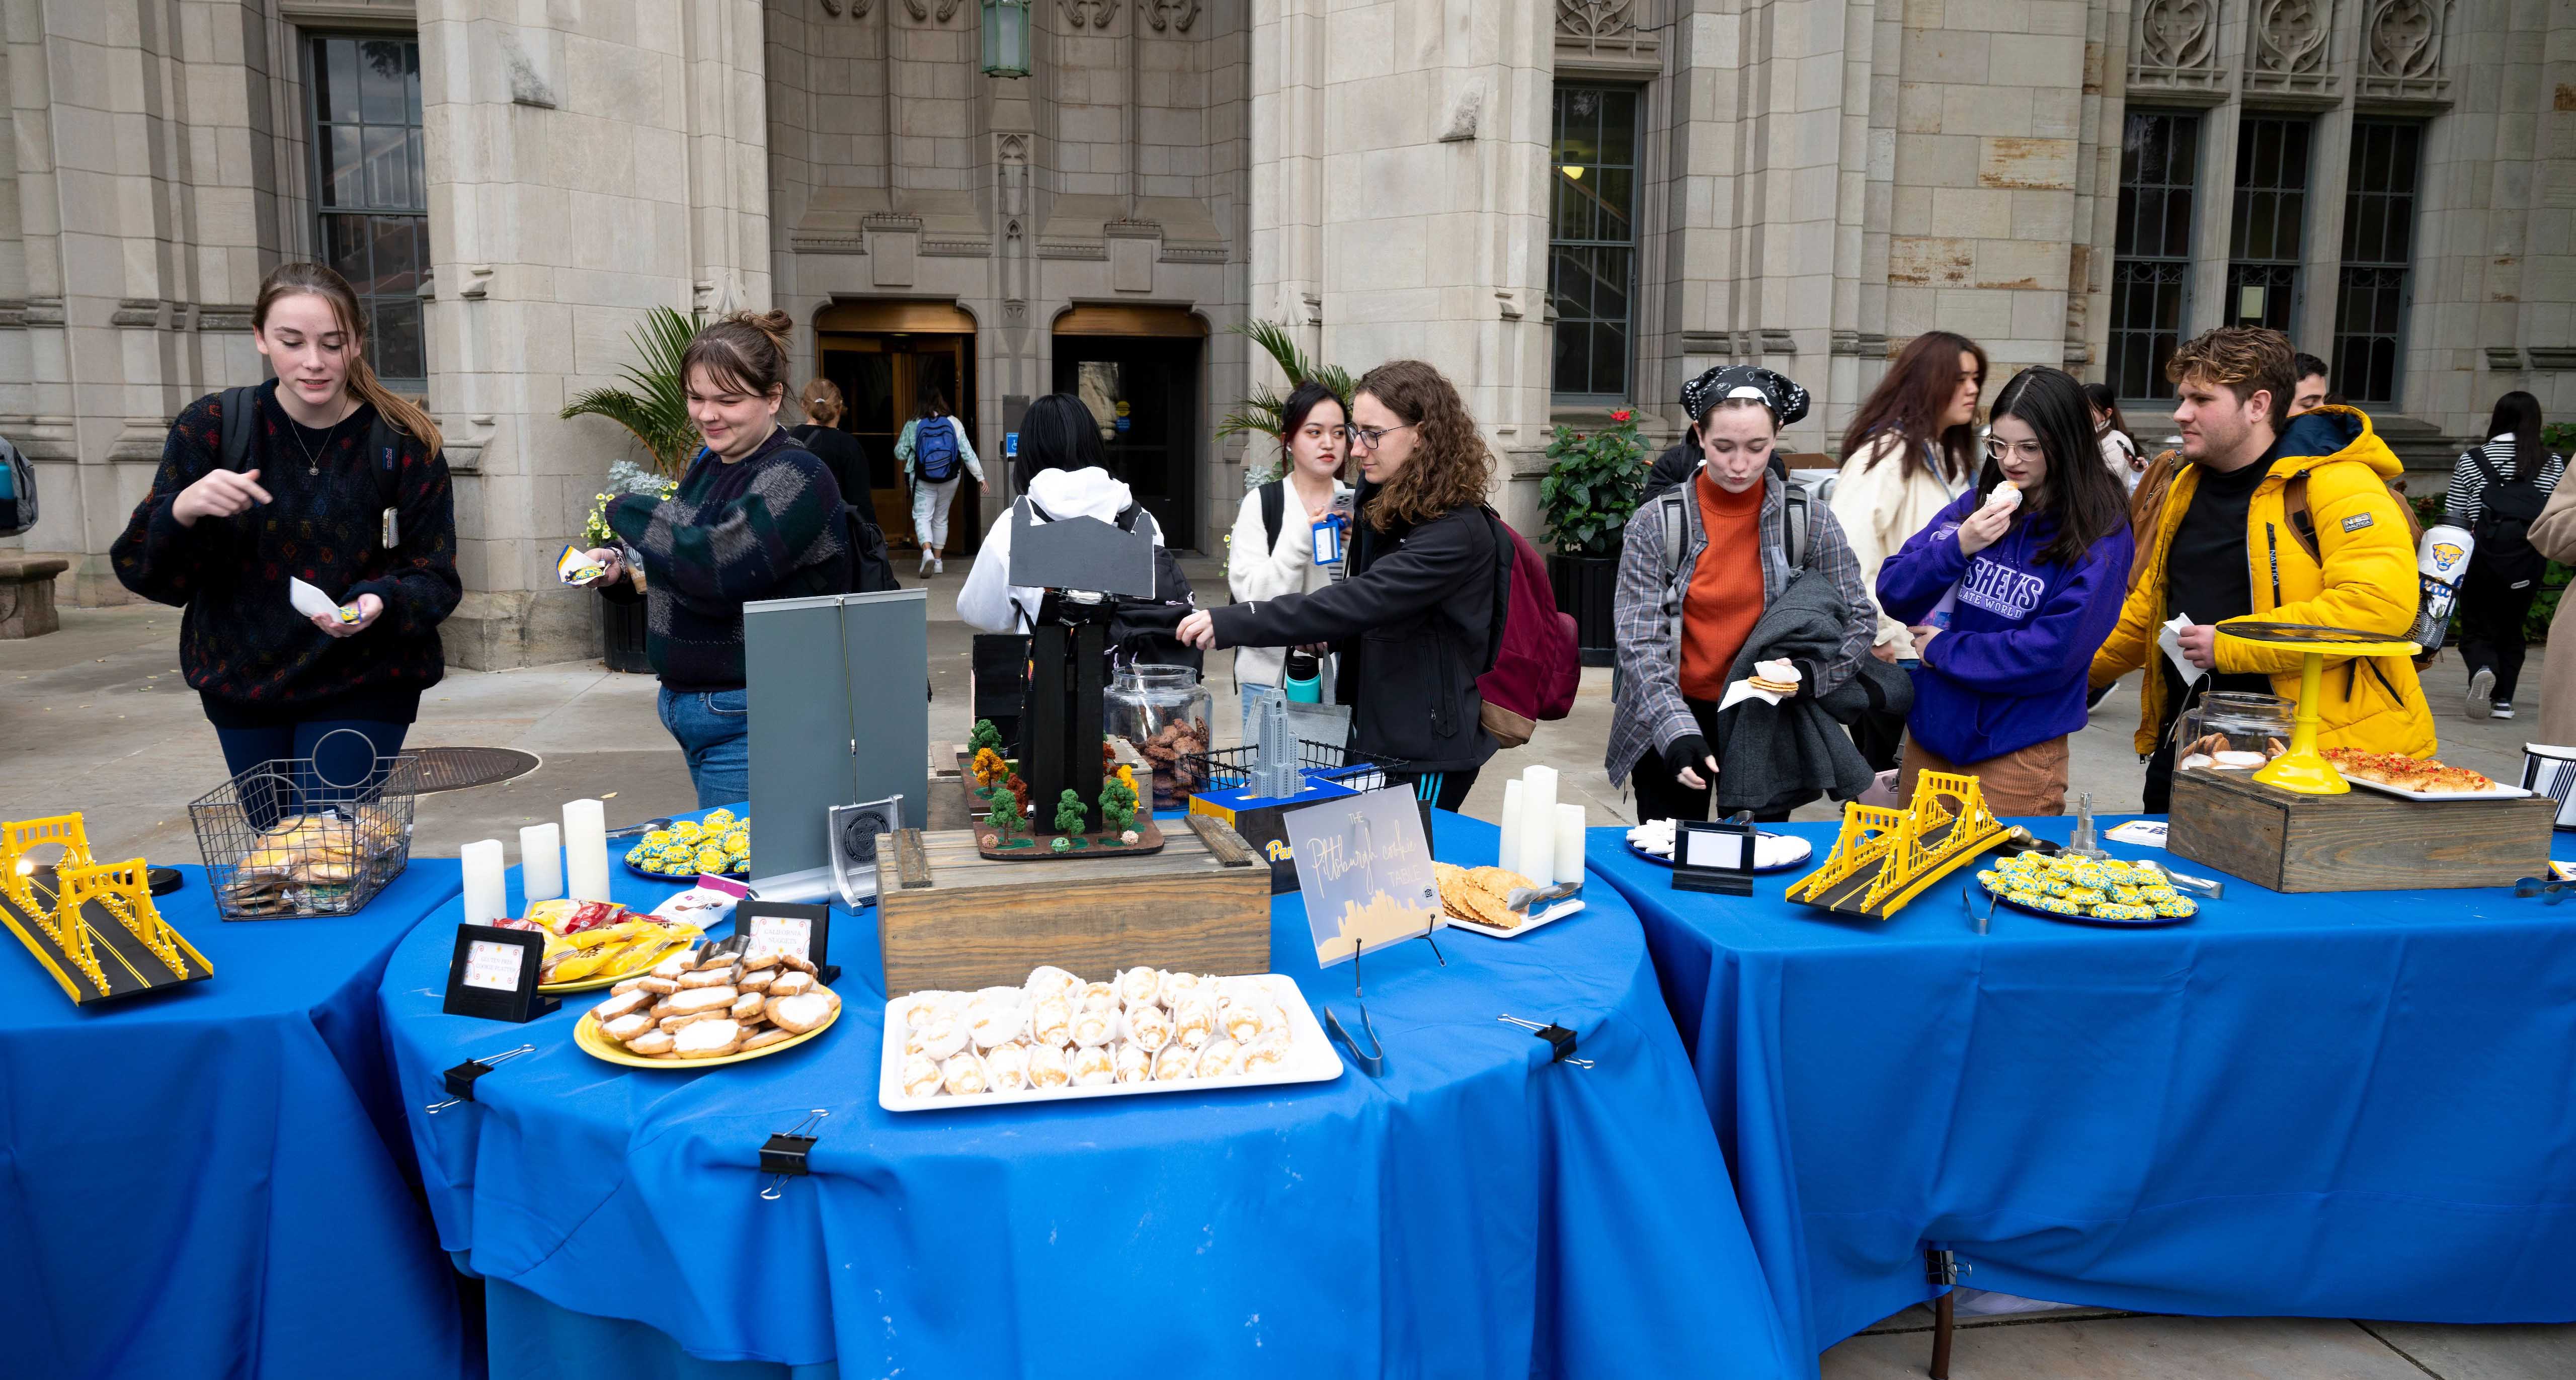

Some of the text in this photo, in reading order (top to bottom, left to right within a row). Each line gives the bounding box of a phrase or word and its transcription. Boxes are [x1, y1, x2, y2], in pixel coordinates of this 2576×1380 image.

[2346, 520, 2371, 530] NAUTICA
[2270, 549, 2279, 586] NAUTICA
[1963, 556, 2045, 612] SHEY'S
[1985, 598, 2023, 619] WORLD
[1348, 811, 1364, 825] THE
[1266, 839, 1295, 862] Pan
[1307, 819, 1416, 899] Pittsburgh cookie
[1387, 865, 1421, 888] TABLE
